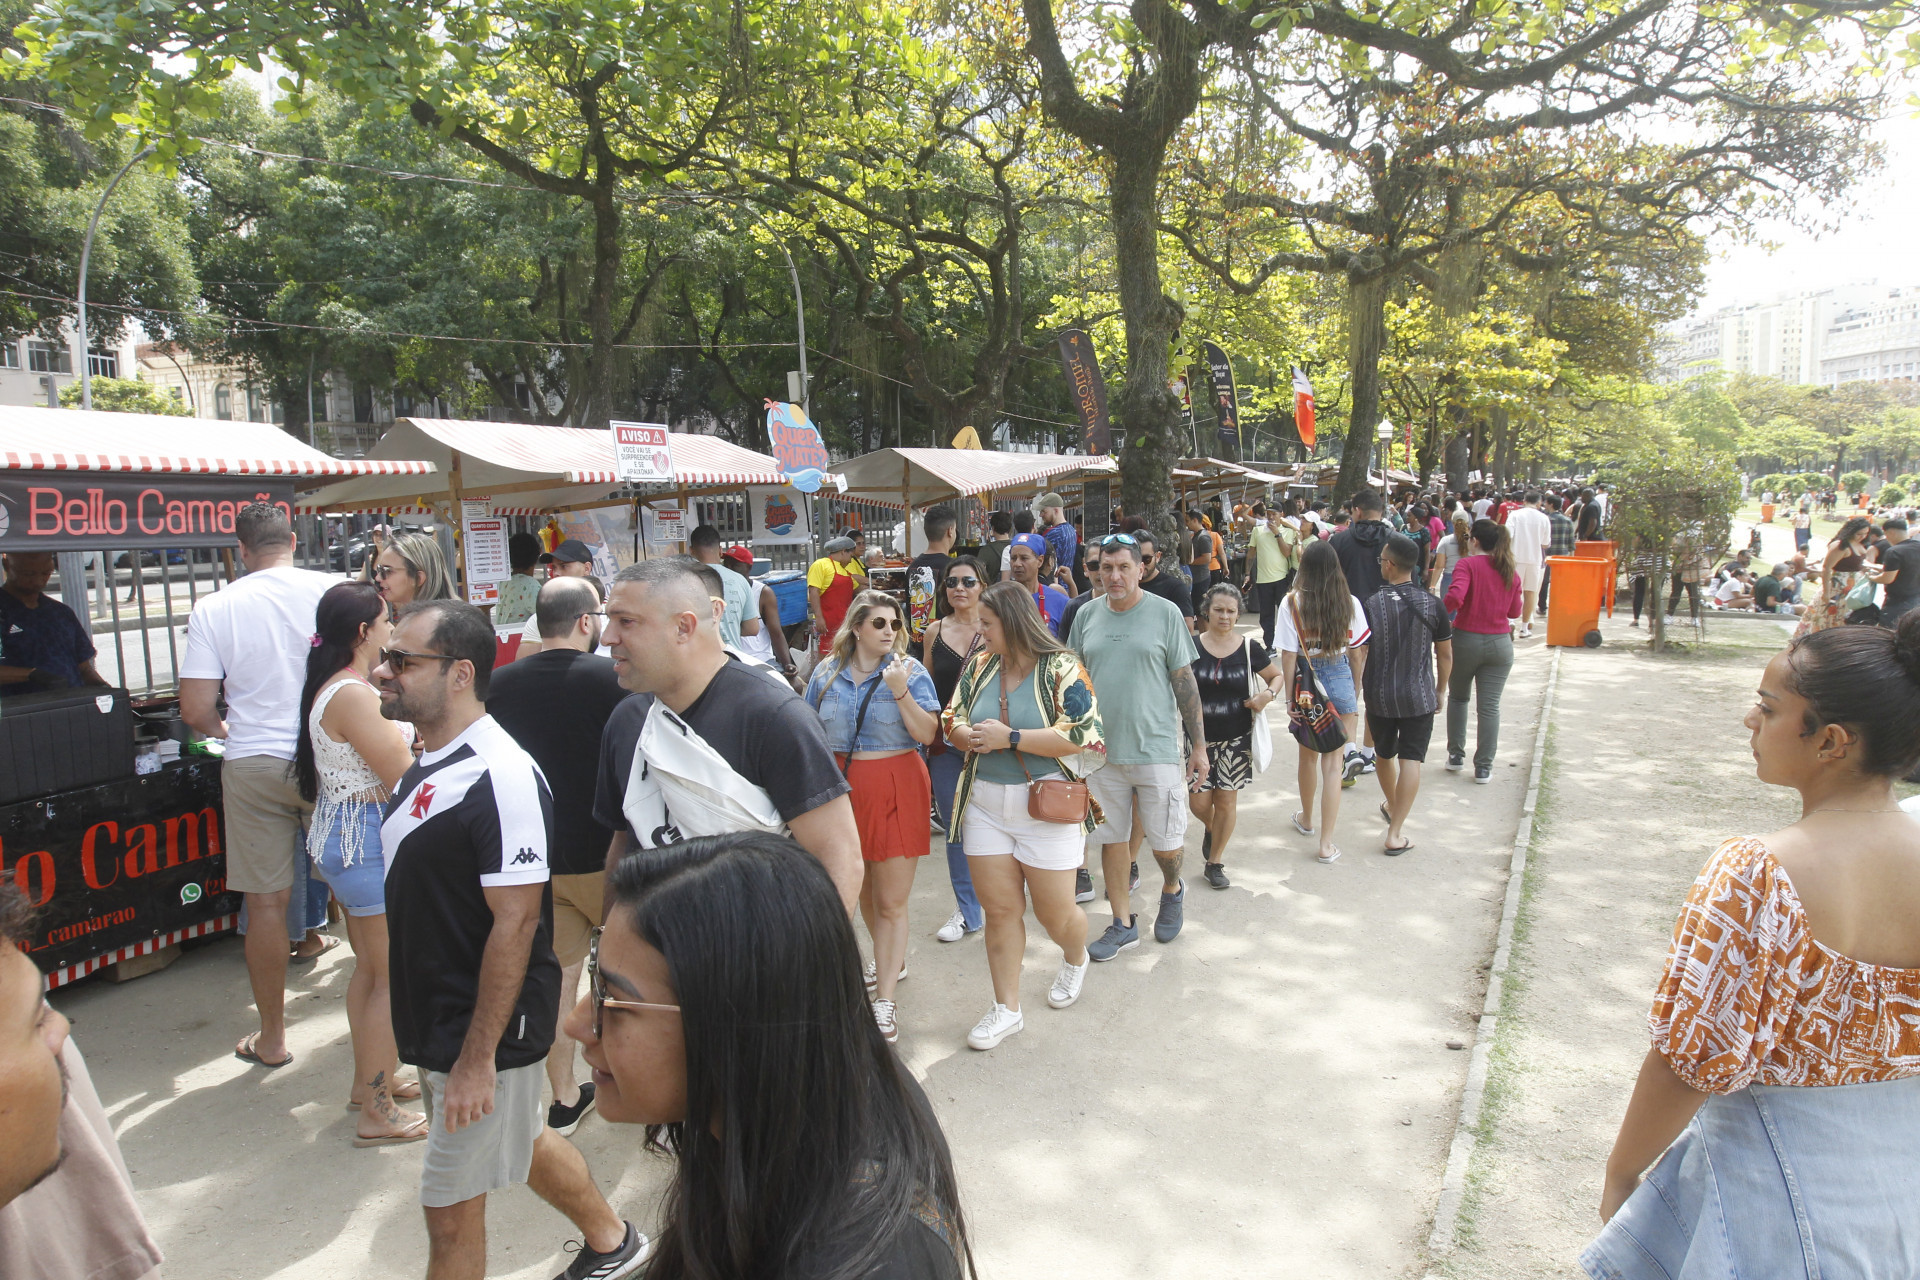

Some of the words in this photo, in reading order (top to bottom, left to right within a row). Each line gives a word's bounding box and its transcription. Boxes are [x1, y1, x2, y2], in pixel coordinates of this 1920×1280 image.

[621, 430, 650, 443] AVISO
[773, 445, 828, 472] MATE?
[27, 487, 127, 536] Bello
[81, 807, 224, 890] Cam
[205, 872, 227, 898] (21
[17, 906, 136, 954] o_camarao
